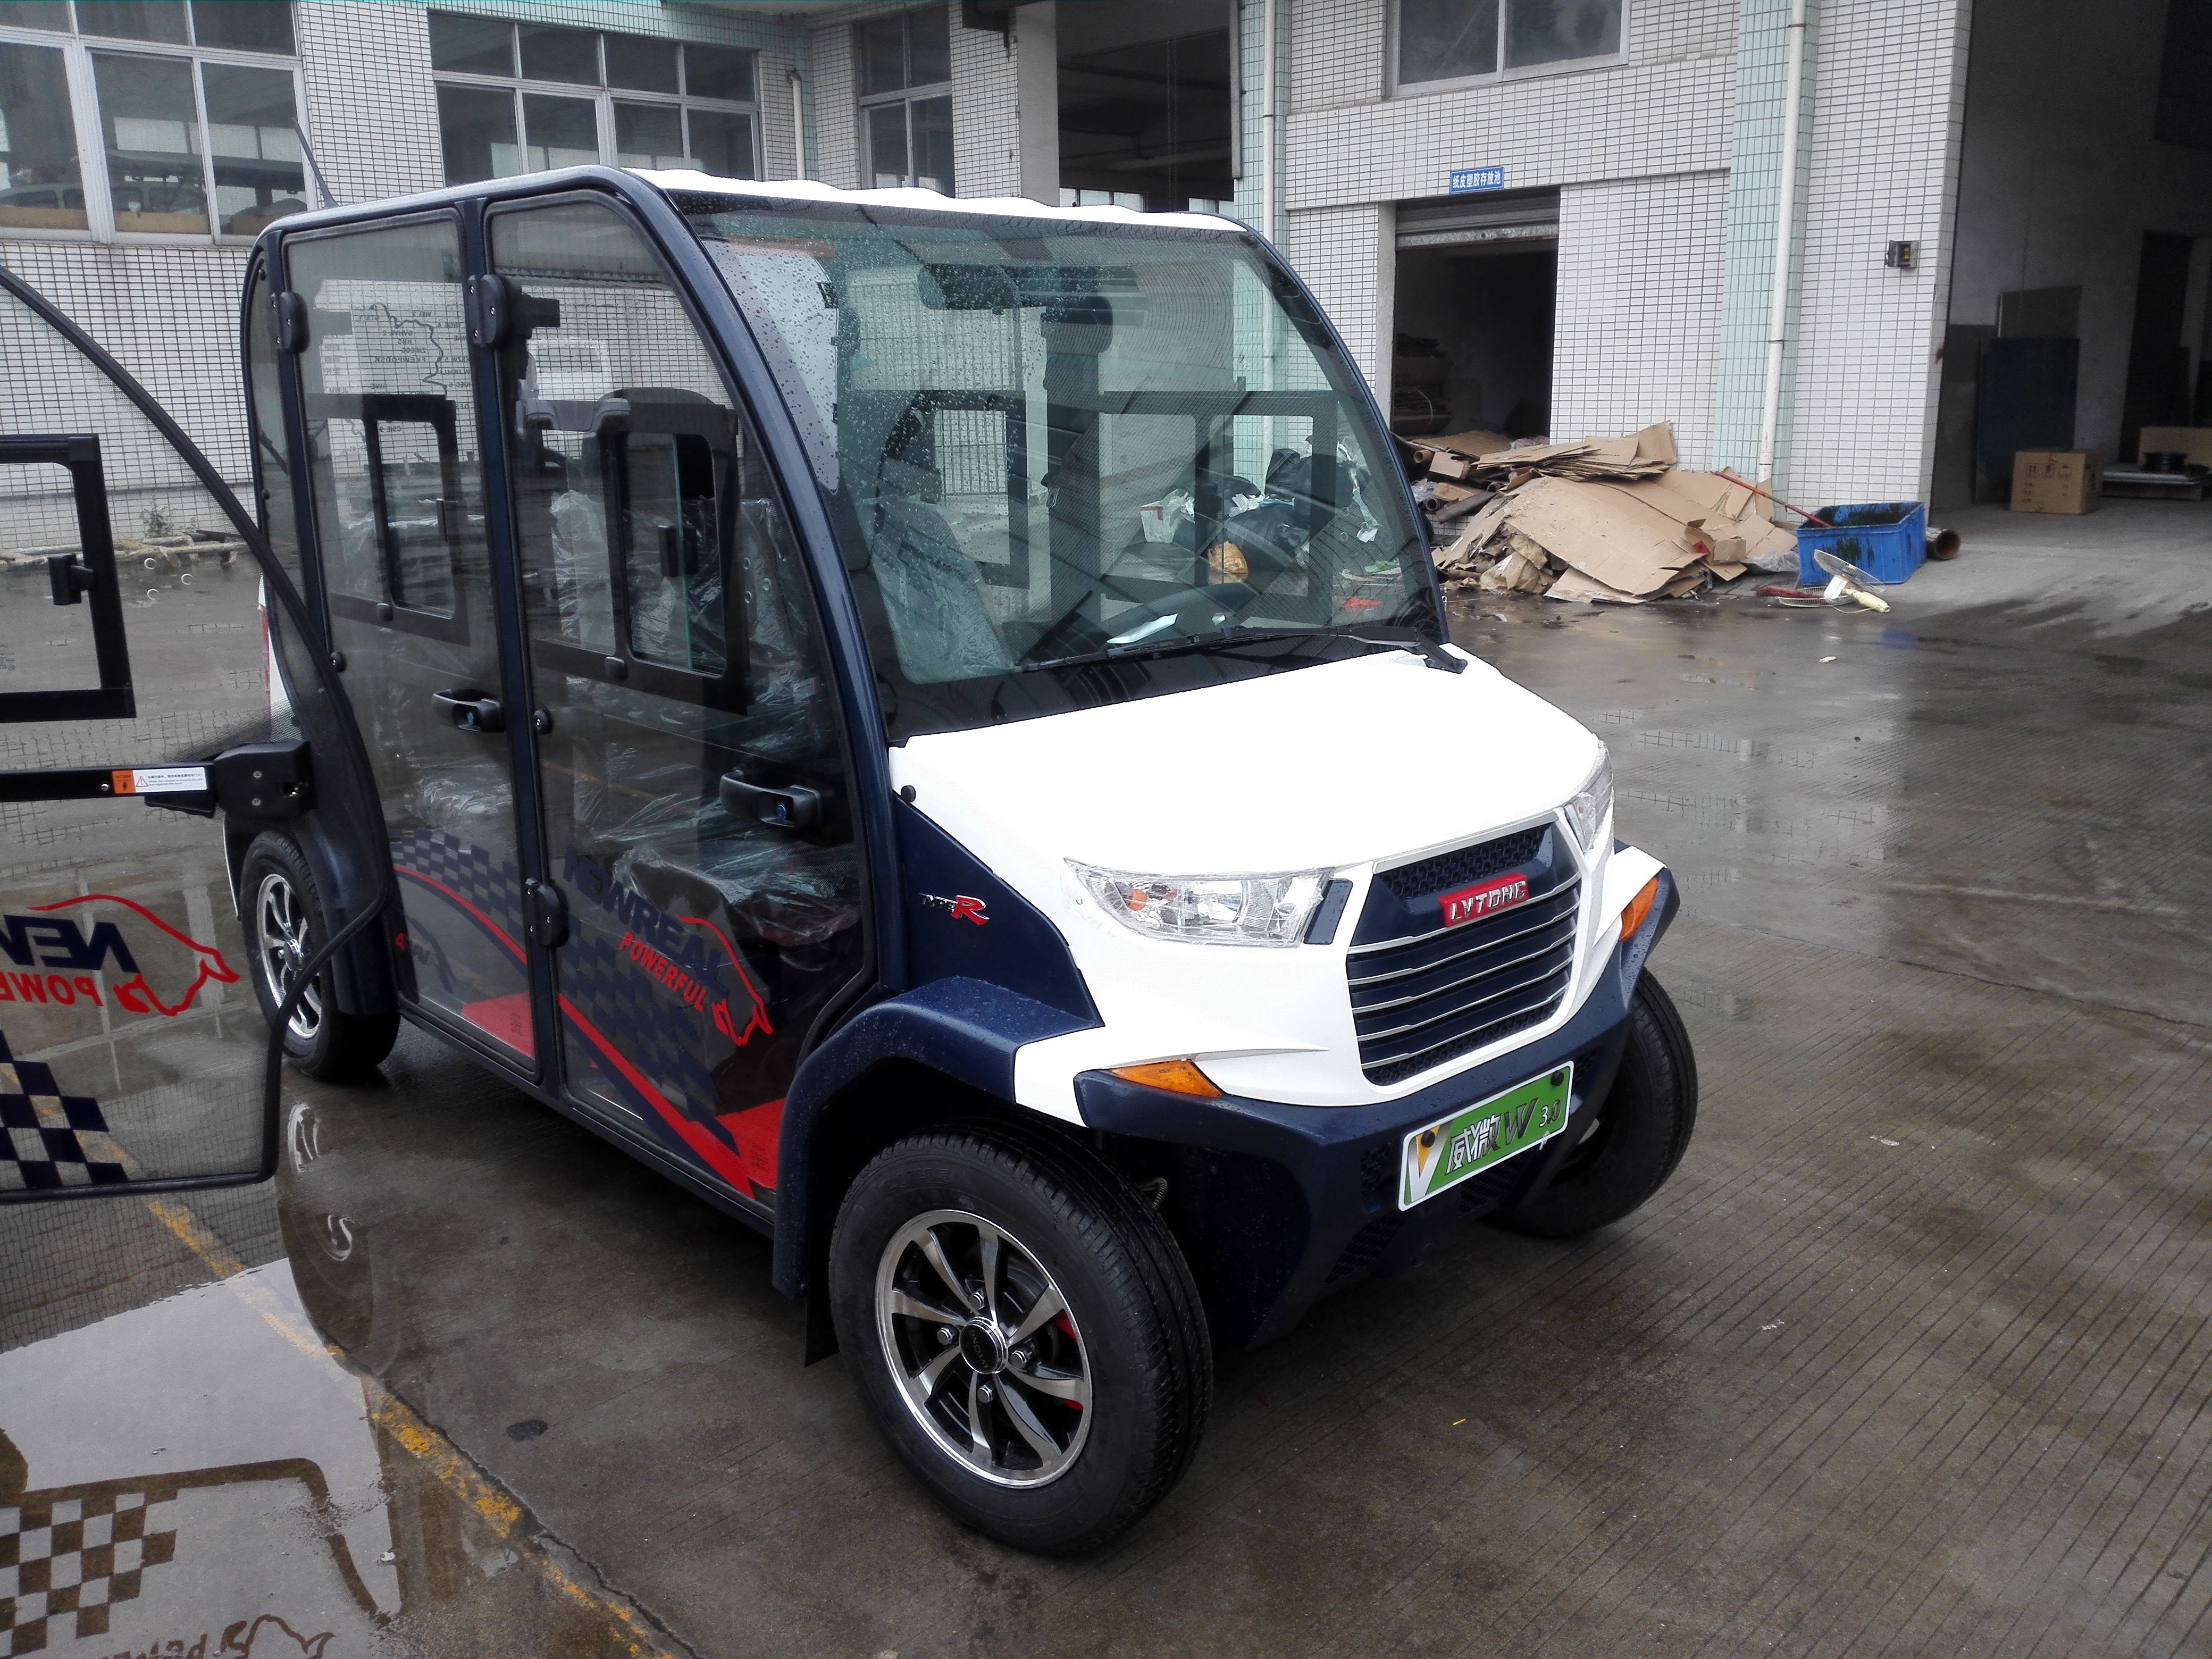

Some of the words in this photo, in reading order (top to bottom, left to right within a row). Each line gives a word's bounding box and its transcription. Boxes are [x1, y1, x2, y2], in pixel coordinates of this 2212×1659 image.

[1453, 170, 1501, 189] 纸皮塑胶存放池
[619, 932, 707, 1011] POWERFUL
[1539, 1099, 1562, 1128] 3.0
